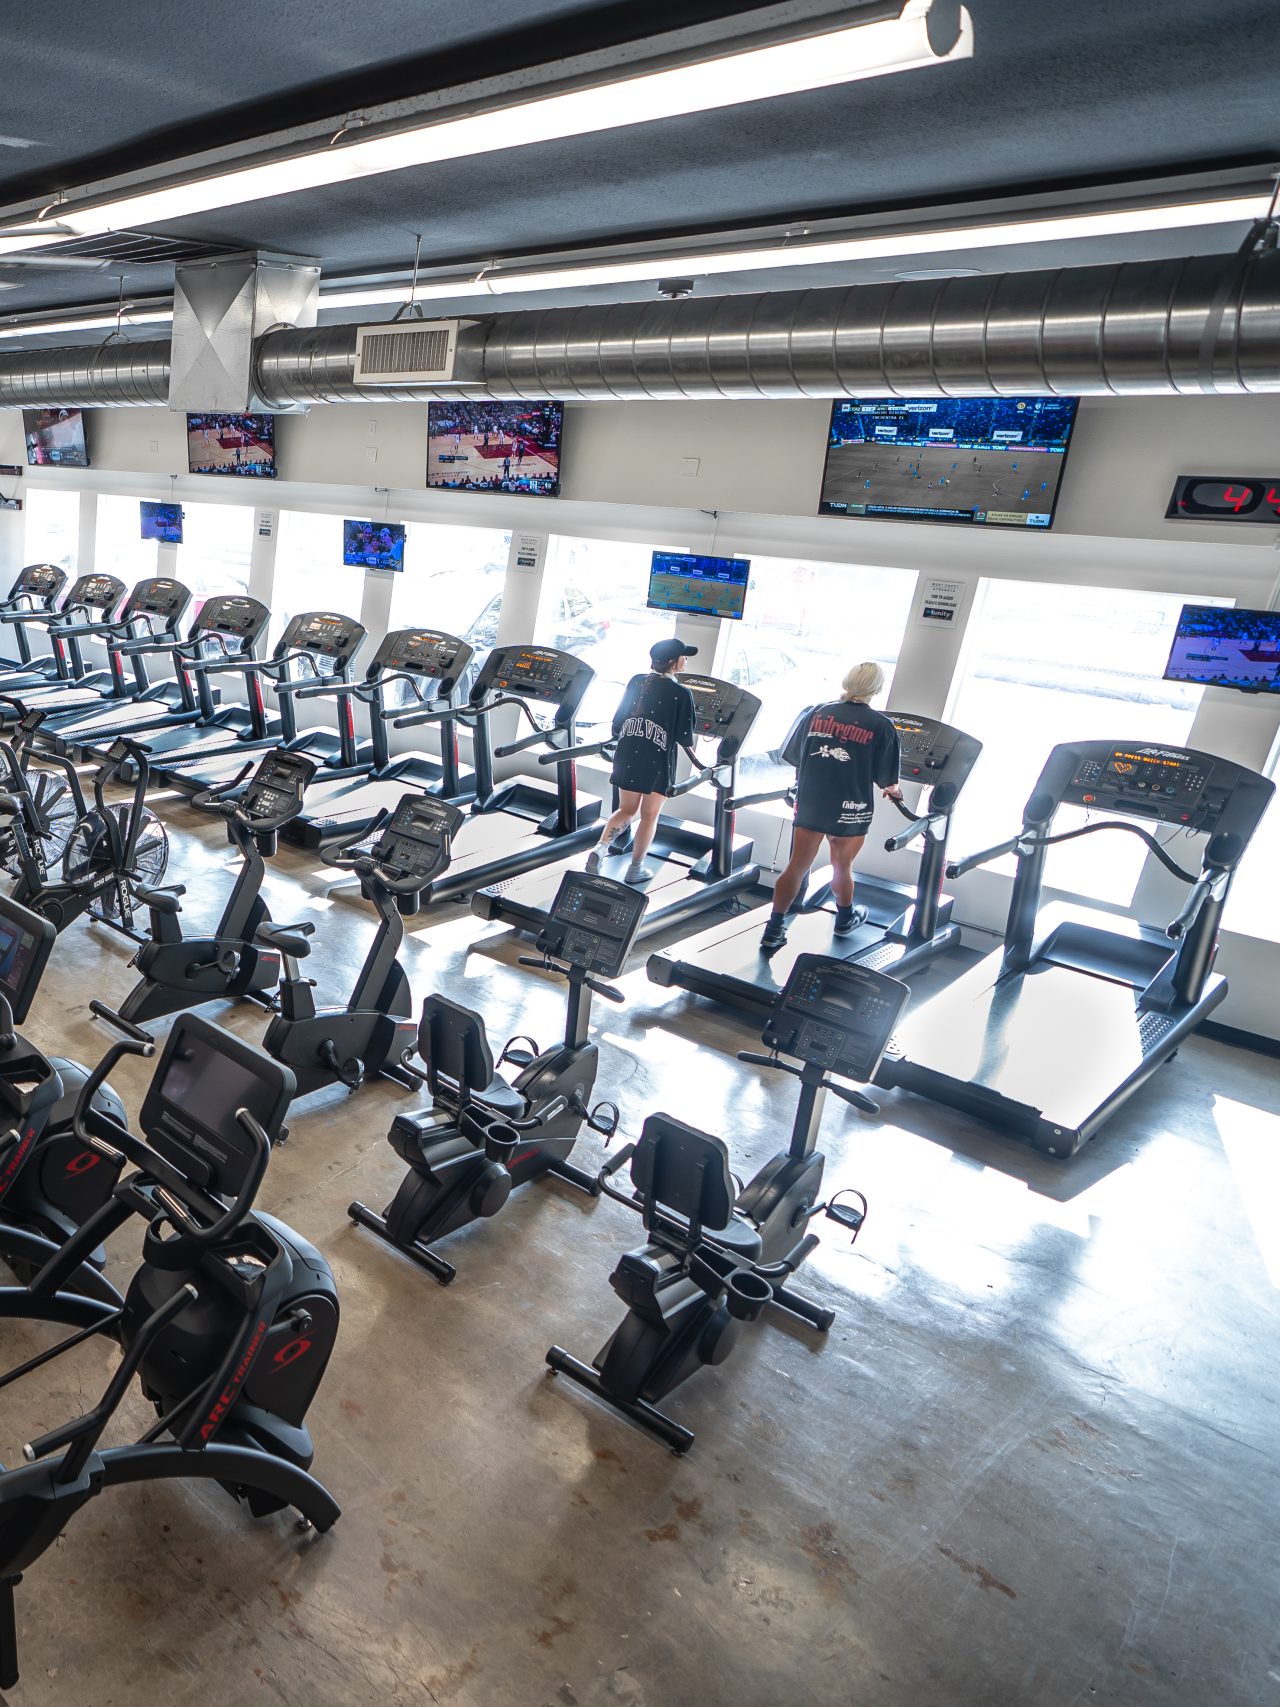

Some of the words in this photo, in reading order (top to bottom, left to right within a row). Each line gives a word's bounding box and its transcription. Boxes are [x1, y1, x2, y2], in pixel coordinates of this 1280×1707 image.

[619, 718, 667, 751] WOLVES
[34, 839, 46, 875] ROUE
[120, 879, 132, 919] ROGUE
[201, 1384, 236, 1440] ARC
